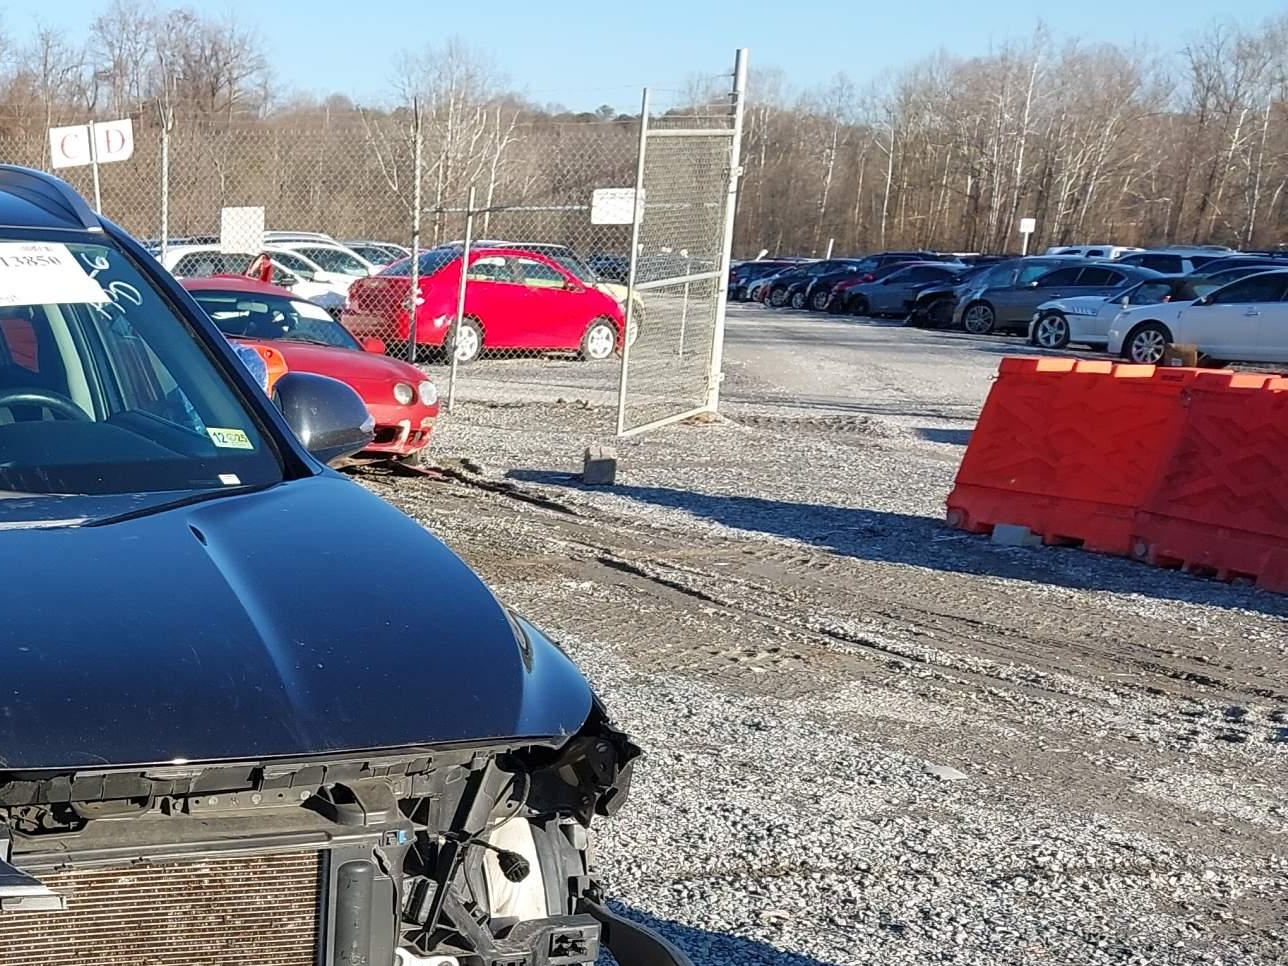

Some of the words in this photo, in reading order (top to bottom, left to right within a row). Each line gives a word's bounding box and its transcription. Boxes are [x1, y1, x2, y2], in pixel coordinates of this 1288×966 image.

[60, 132, 80, 160] C
[105, 128, 126, 154] D
[212, 431, 229, 444] 12
